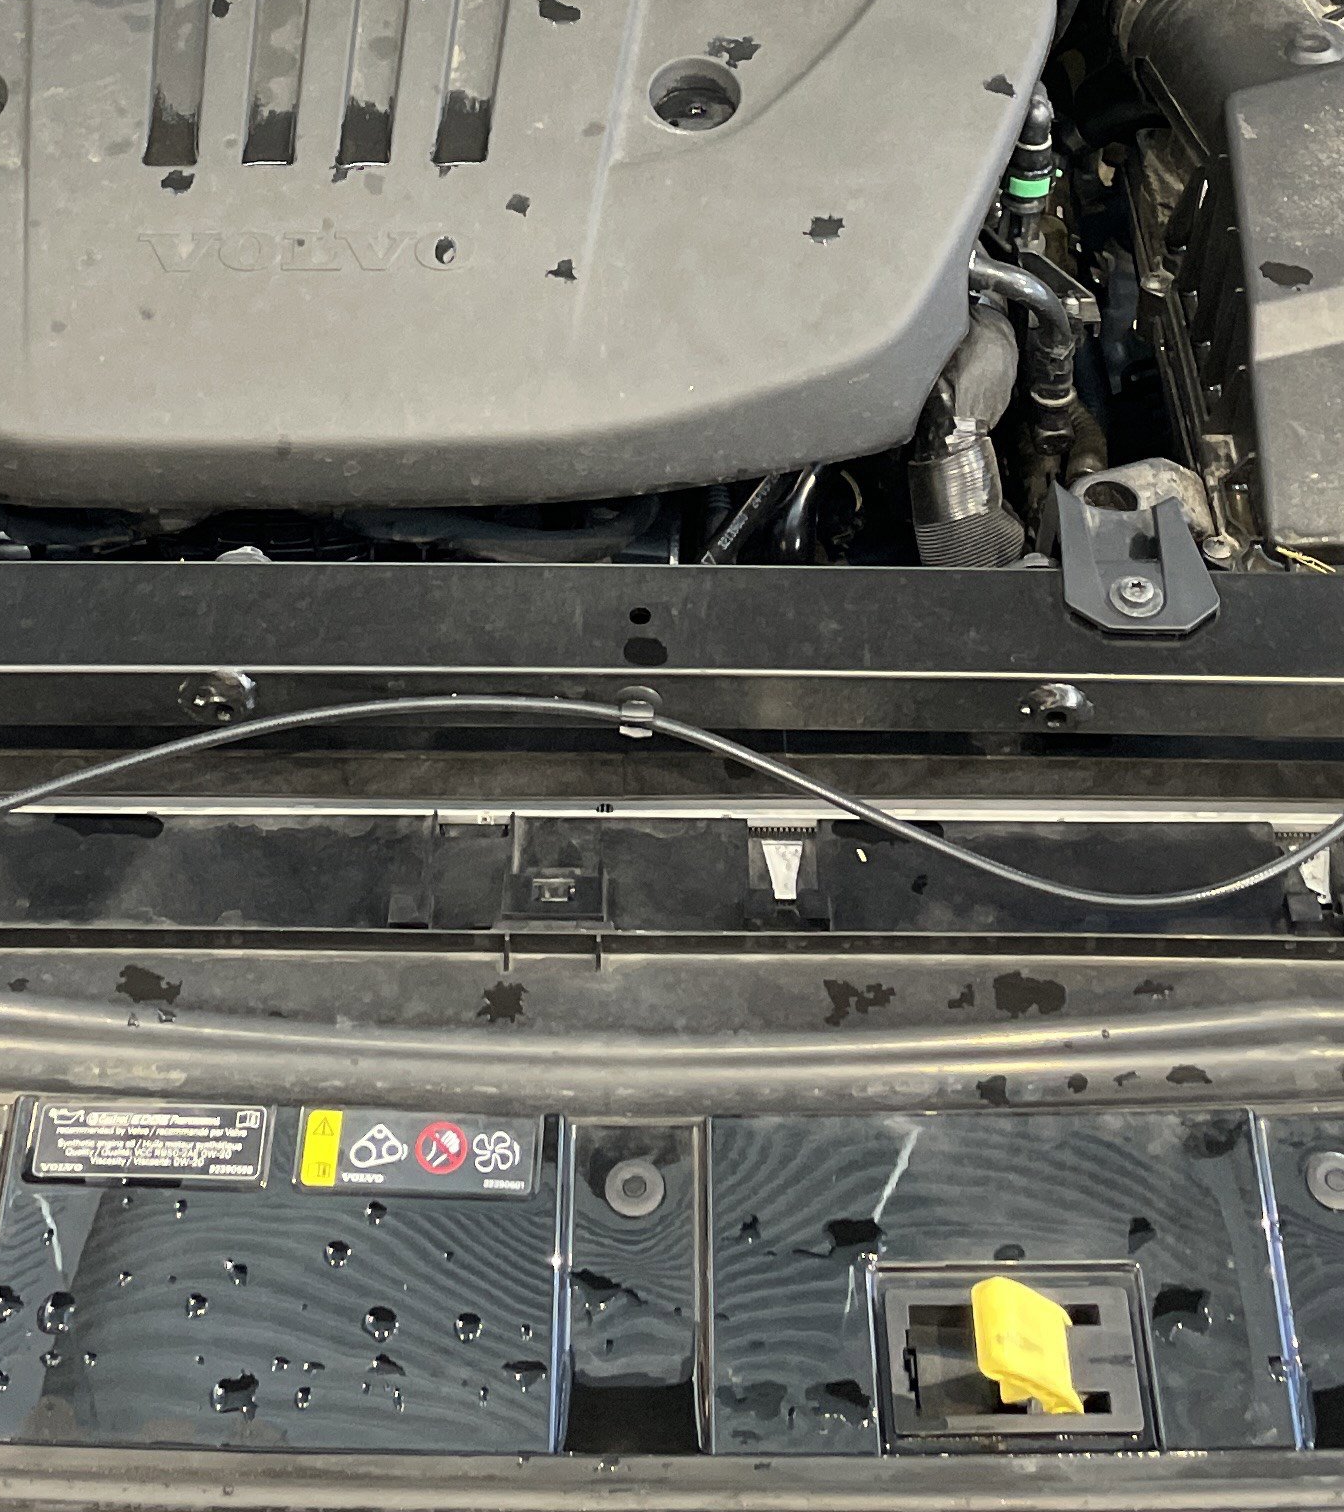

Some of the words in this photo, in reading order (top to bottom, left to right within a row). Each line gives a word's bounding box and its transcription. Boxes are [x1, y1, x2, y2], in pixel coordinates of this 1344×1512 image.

[137, 230, 477, 273] VOLVO
[127, 1127, 149, 1137] Volvo
[225, 1128, 248, 1138] Volvo
[41, 1163, 83, 1172] VOLVO
[341, 1172, 384, 1183] VOLVO
